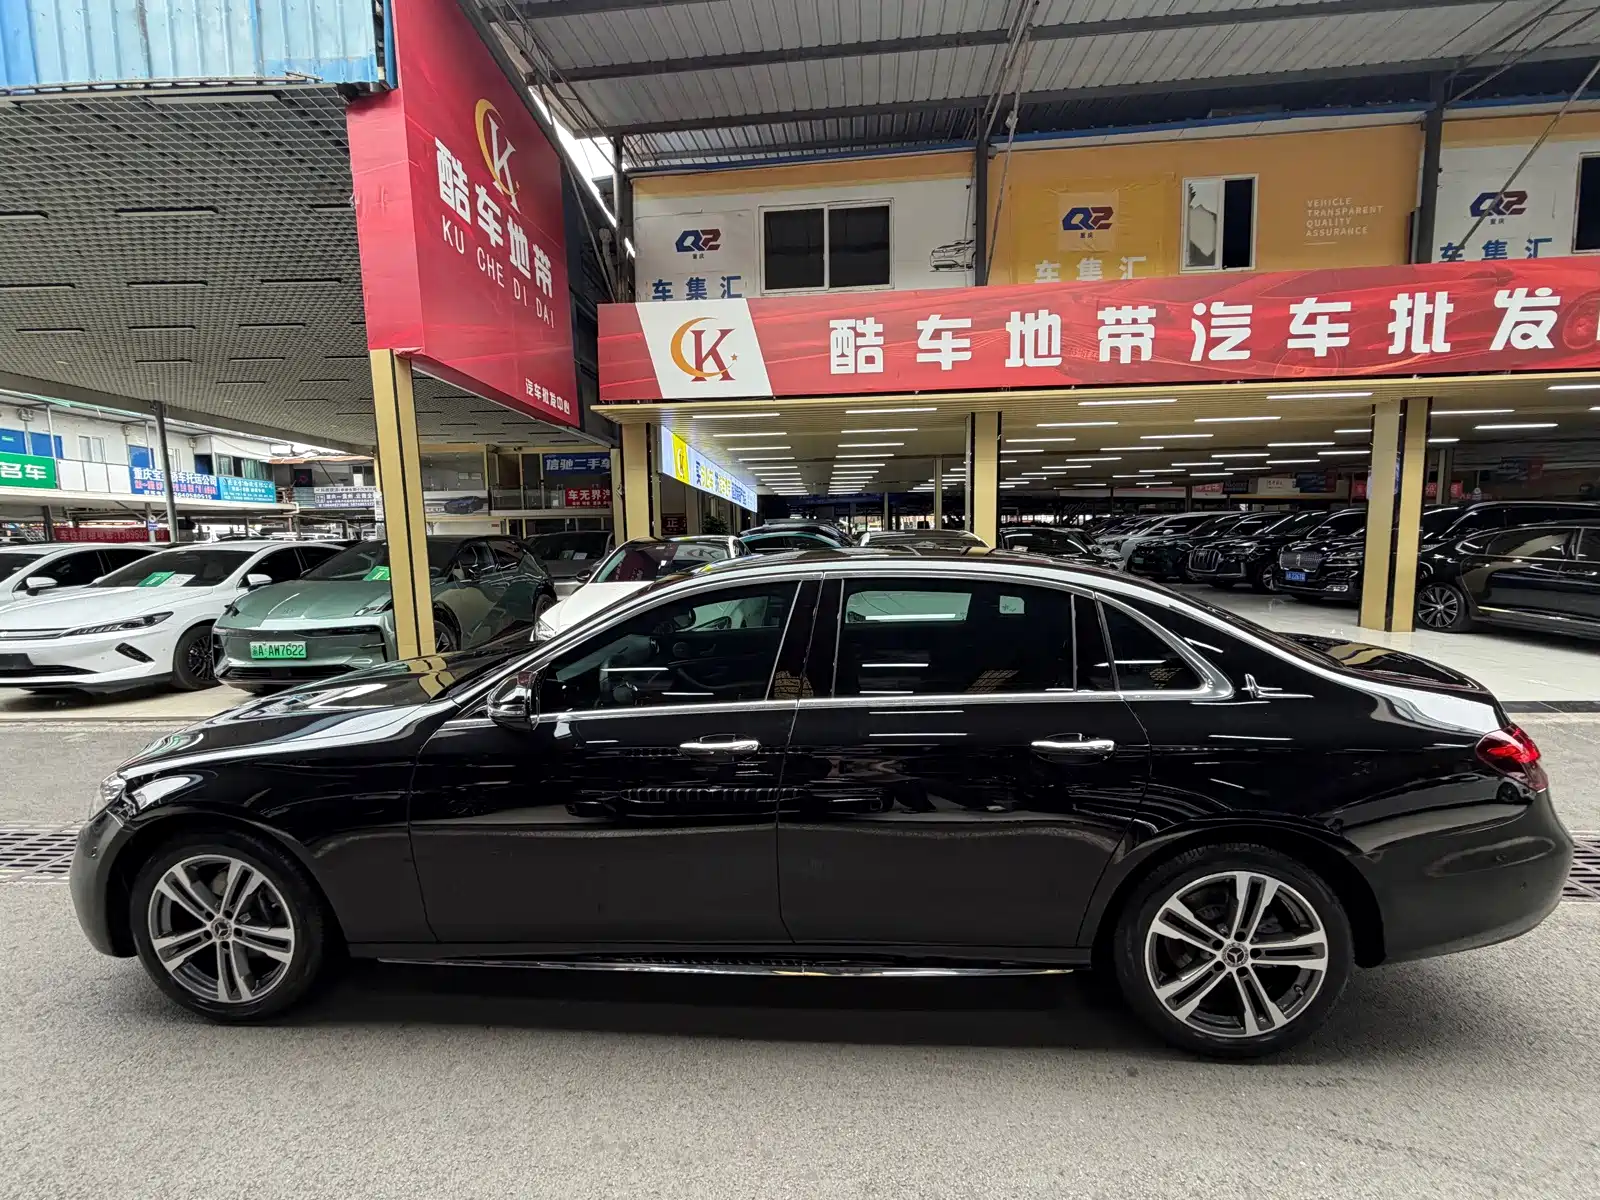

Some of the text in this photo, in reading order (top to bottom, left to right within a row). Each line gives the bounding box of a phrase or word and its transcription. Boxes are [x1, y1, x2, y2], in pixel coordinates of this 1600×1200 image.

[1307, 197, 1352, 208] VEHICLE
[1307, 205, 1384, 217] TRANSPARENT
[435, 136, 553, 299] 酷车地带
[1306, 217, 1352, 229] QUALITY
[1306, 226, 1369, 237] ASSURANCE
[441, 215, 555, 329] KU CHE DI DAI
[652, 275, 742, 302] 车集汇
[829, 286, 1600, 375] 酷车地带汽车批发
[525, 377, 571, 416] 汽车批发中心
